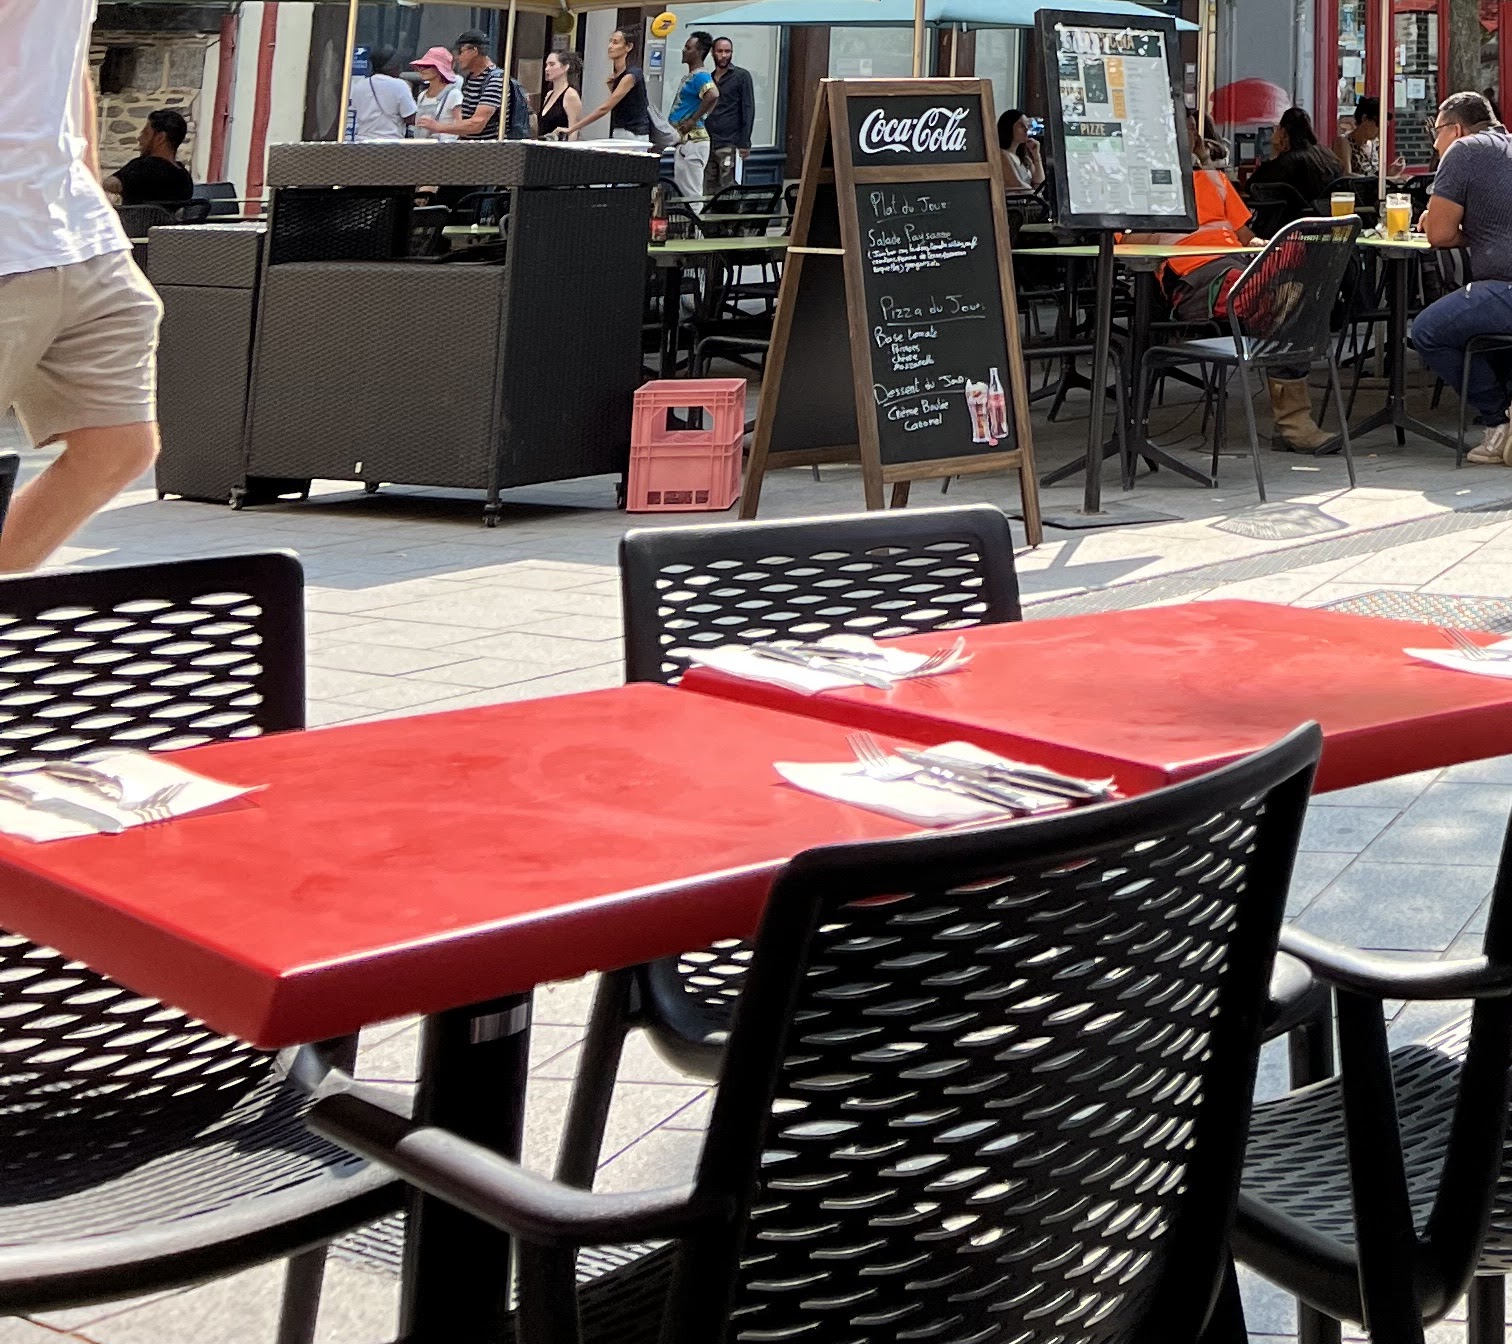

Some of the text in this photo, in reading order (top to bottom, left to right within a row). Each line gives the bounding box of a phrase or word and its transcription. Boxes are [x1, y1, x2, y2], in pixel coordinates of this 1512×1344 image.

[859, 107, 969, 154] Coca-Cola
[1080, 123, 1106, 136] PIZZE
[870, 192, 898, 217] Plat
[902, 194, 915, 214] du
[868, 229, 902, 247] Salade
[880, 296, 922, 320] Pizza
[929, 296, 943, 314] du
[874, 326, 904, 347] Base
[873, 377, 921, 405] Dessert
[904, 413, 942, 431] Caramel
